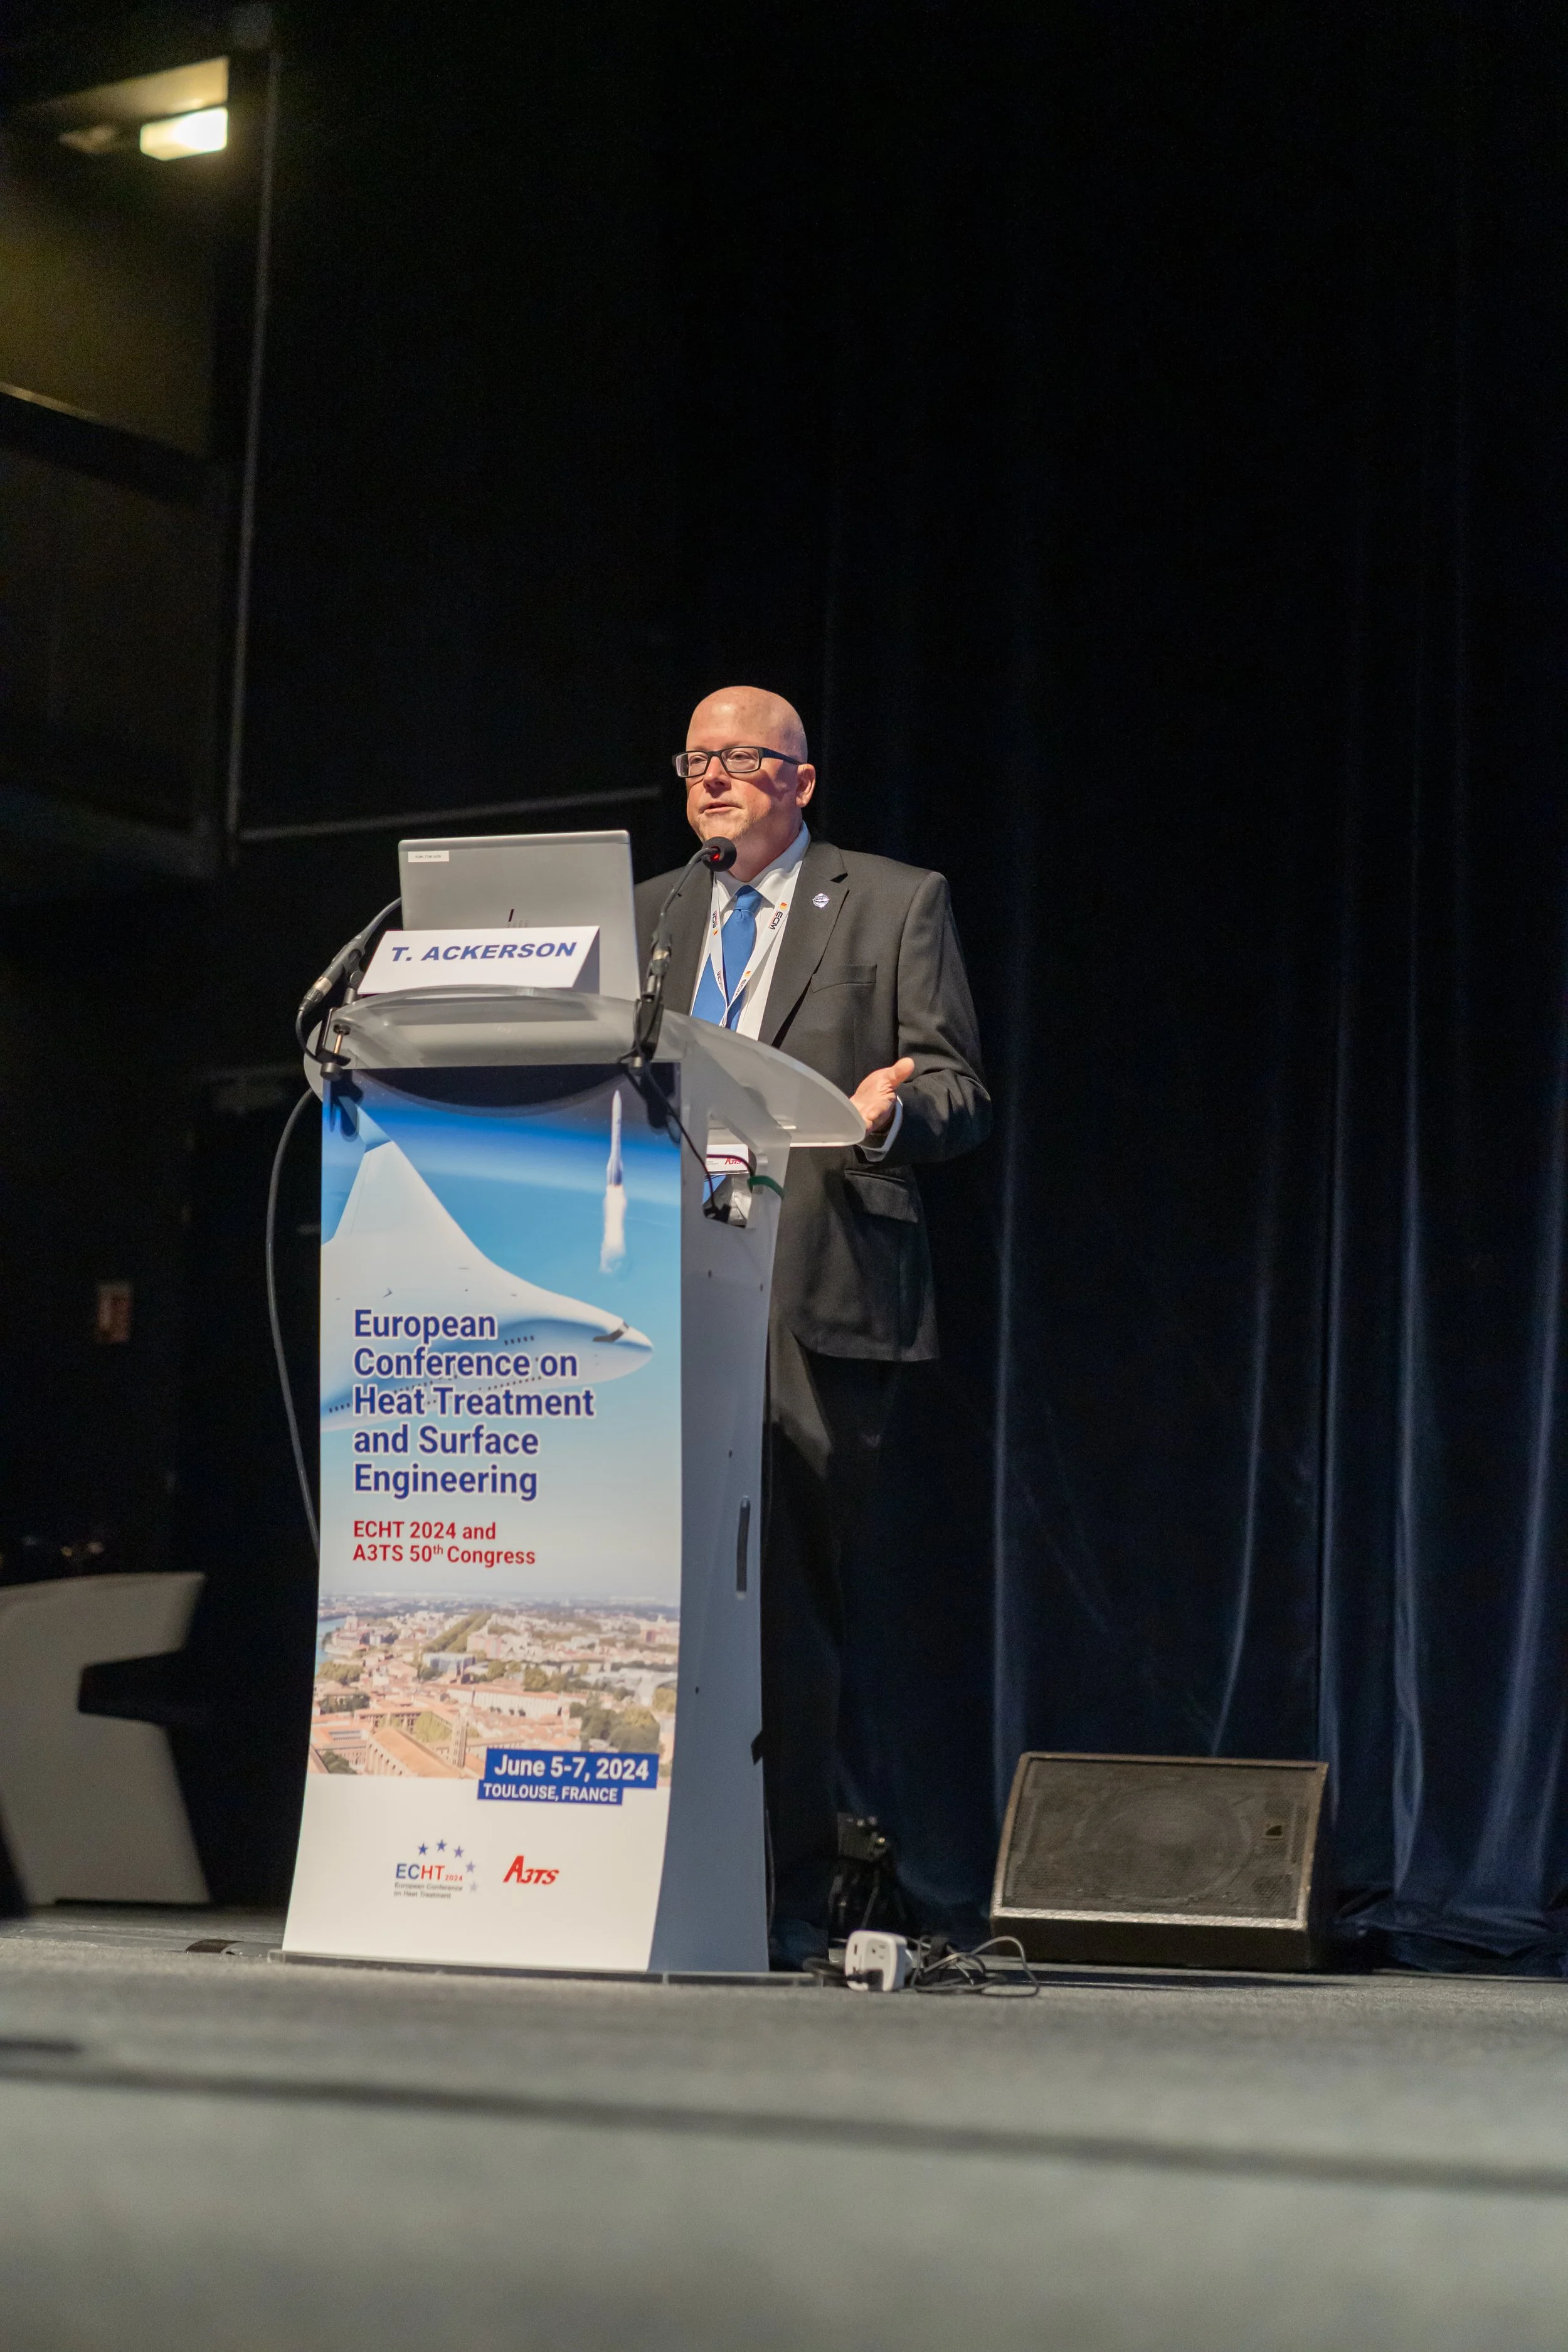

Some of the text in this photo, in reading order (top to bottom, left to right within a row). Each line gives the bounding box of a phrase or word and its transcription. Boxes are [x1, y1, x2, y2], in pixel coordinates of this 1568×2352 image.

[769, 911, 783, 930] ECM
[391, 941, 577, 961] T. ACKERSON
[354, 1309, 495, 1344] European
[354, 1347, 577, 1377] Conference on
[354, 1386, 595, 1416] Heat Treatment
[354, 1424, 539, 1454] and Surface
[354, 1463, 538, 1502] Engineering
[353, 1520, 497, 1540] ECHT 2024 and
[352, 1543, 536, 1569] A3TS 50th Congress
[494, 1754, 649, 1783] June 5-7, 2024
[483, 1783, 618, 1803] TOULOUSE, FRANCE
[395, 1863, 445, 1880] ECHT
[502, 1855, 559, 1885] A3TS
